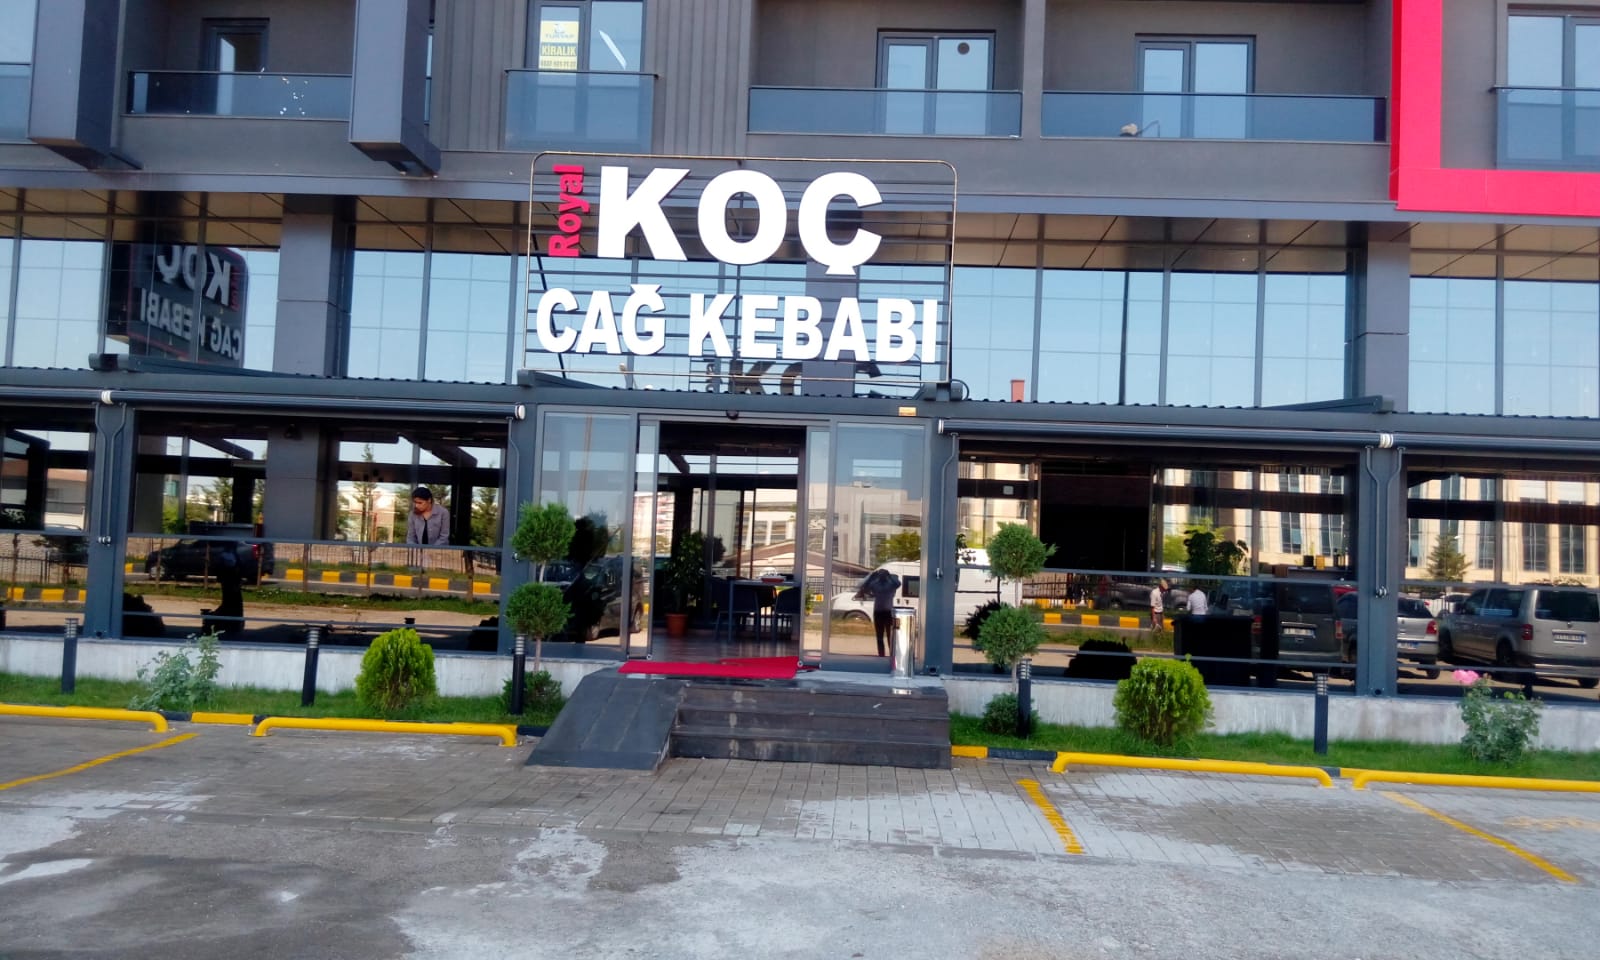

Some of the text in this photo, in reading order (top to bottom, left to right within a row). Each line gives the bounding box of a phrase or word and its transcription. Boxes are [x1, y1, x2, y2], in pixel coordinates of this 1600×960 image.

[548, 164, 590, 258] Royal
[597, 166, 883, 276] KOÇ
[536, 284, 938, 364] CAĞ KEBABI
